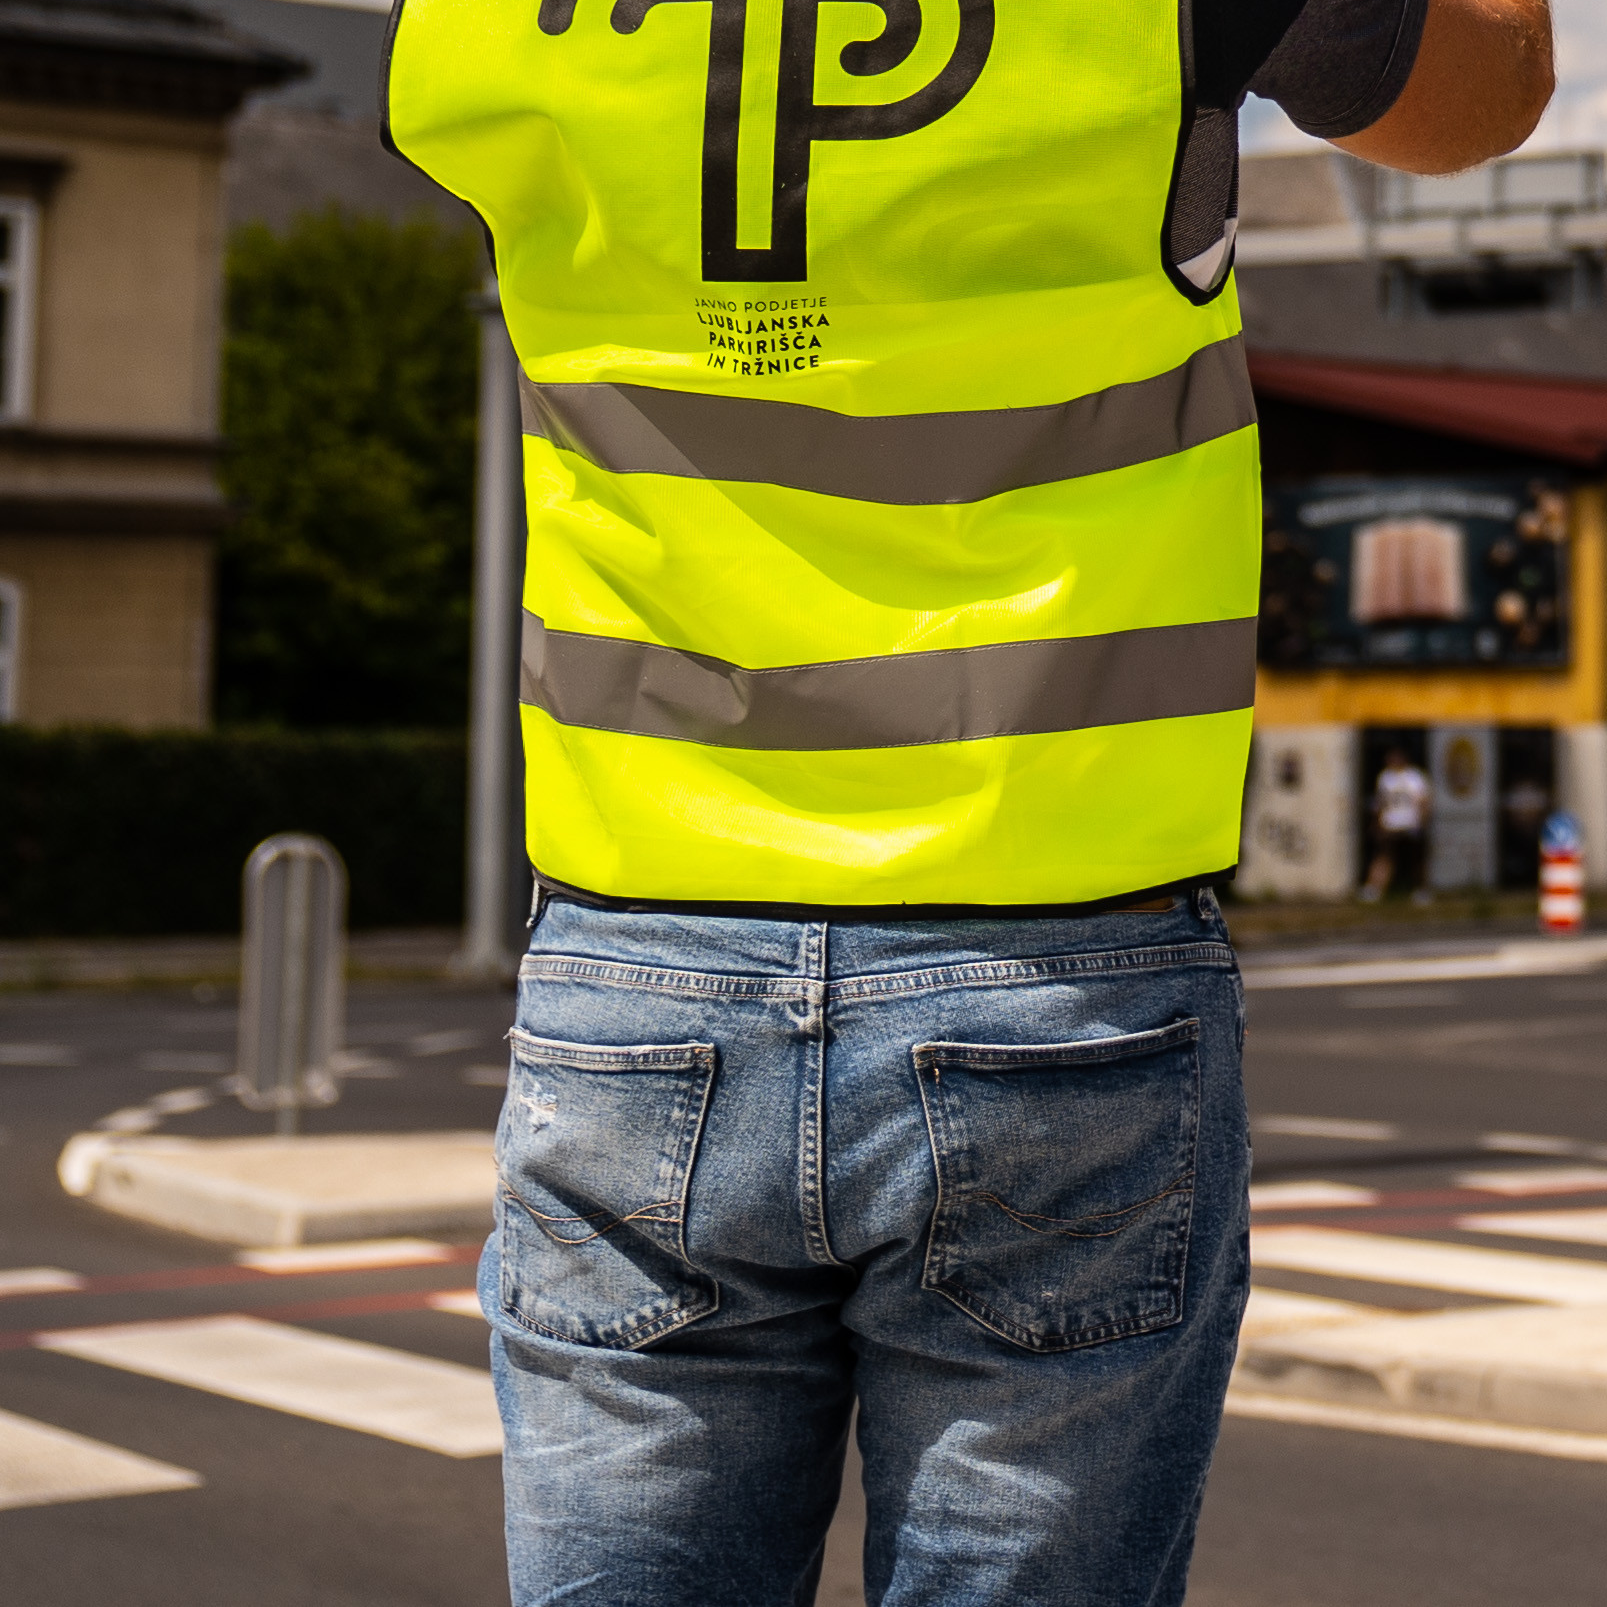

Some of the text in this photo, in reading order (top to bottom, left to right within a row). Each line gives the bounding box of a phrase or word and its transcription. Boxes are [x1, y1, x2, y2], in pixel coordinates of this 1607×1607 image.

[695, 297, 828, 313] JAVNO PODJETJE
[697, 312, 830, 334] LJUBLJANSKA
[709, 331, 822, 355] PARKIRIŠČA
[707, 353, 819, 376] IN TRŽNICE
